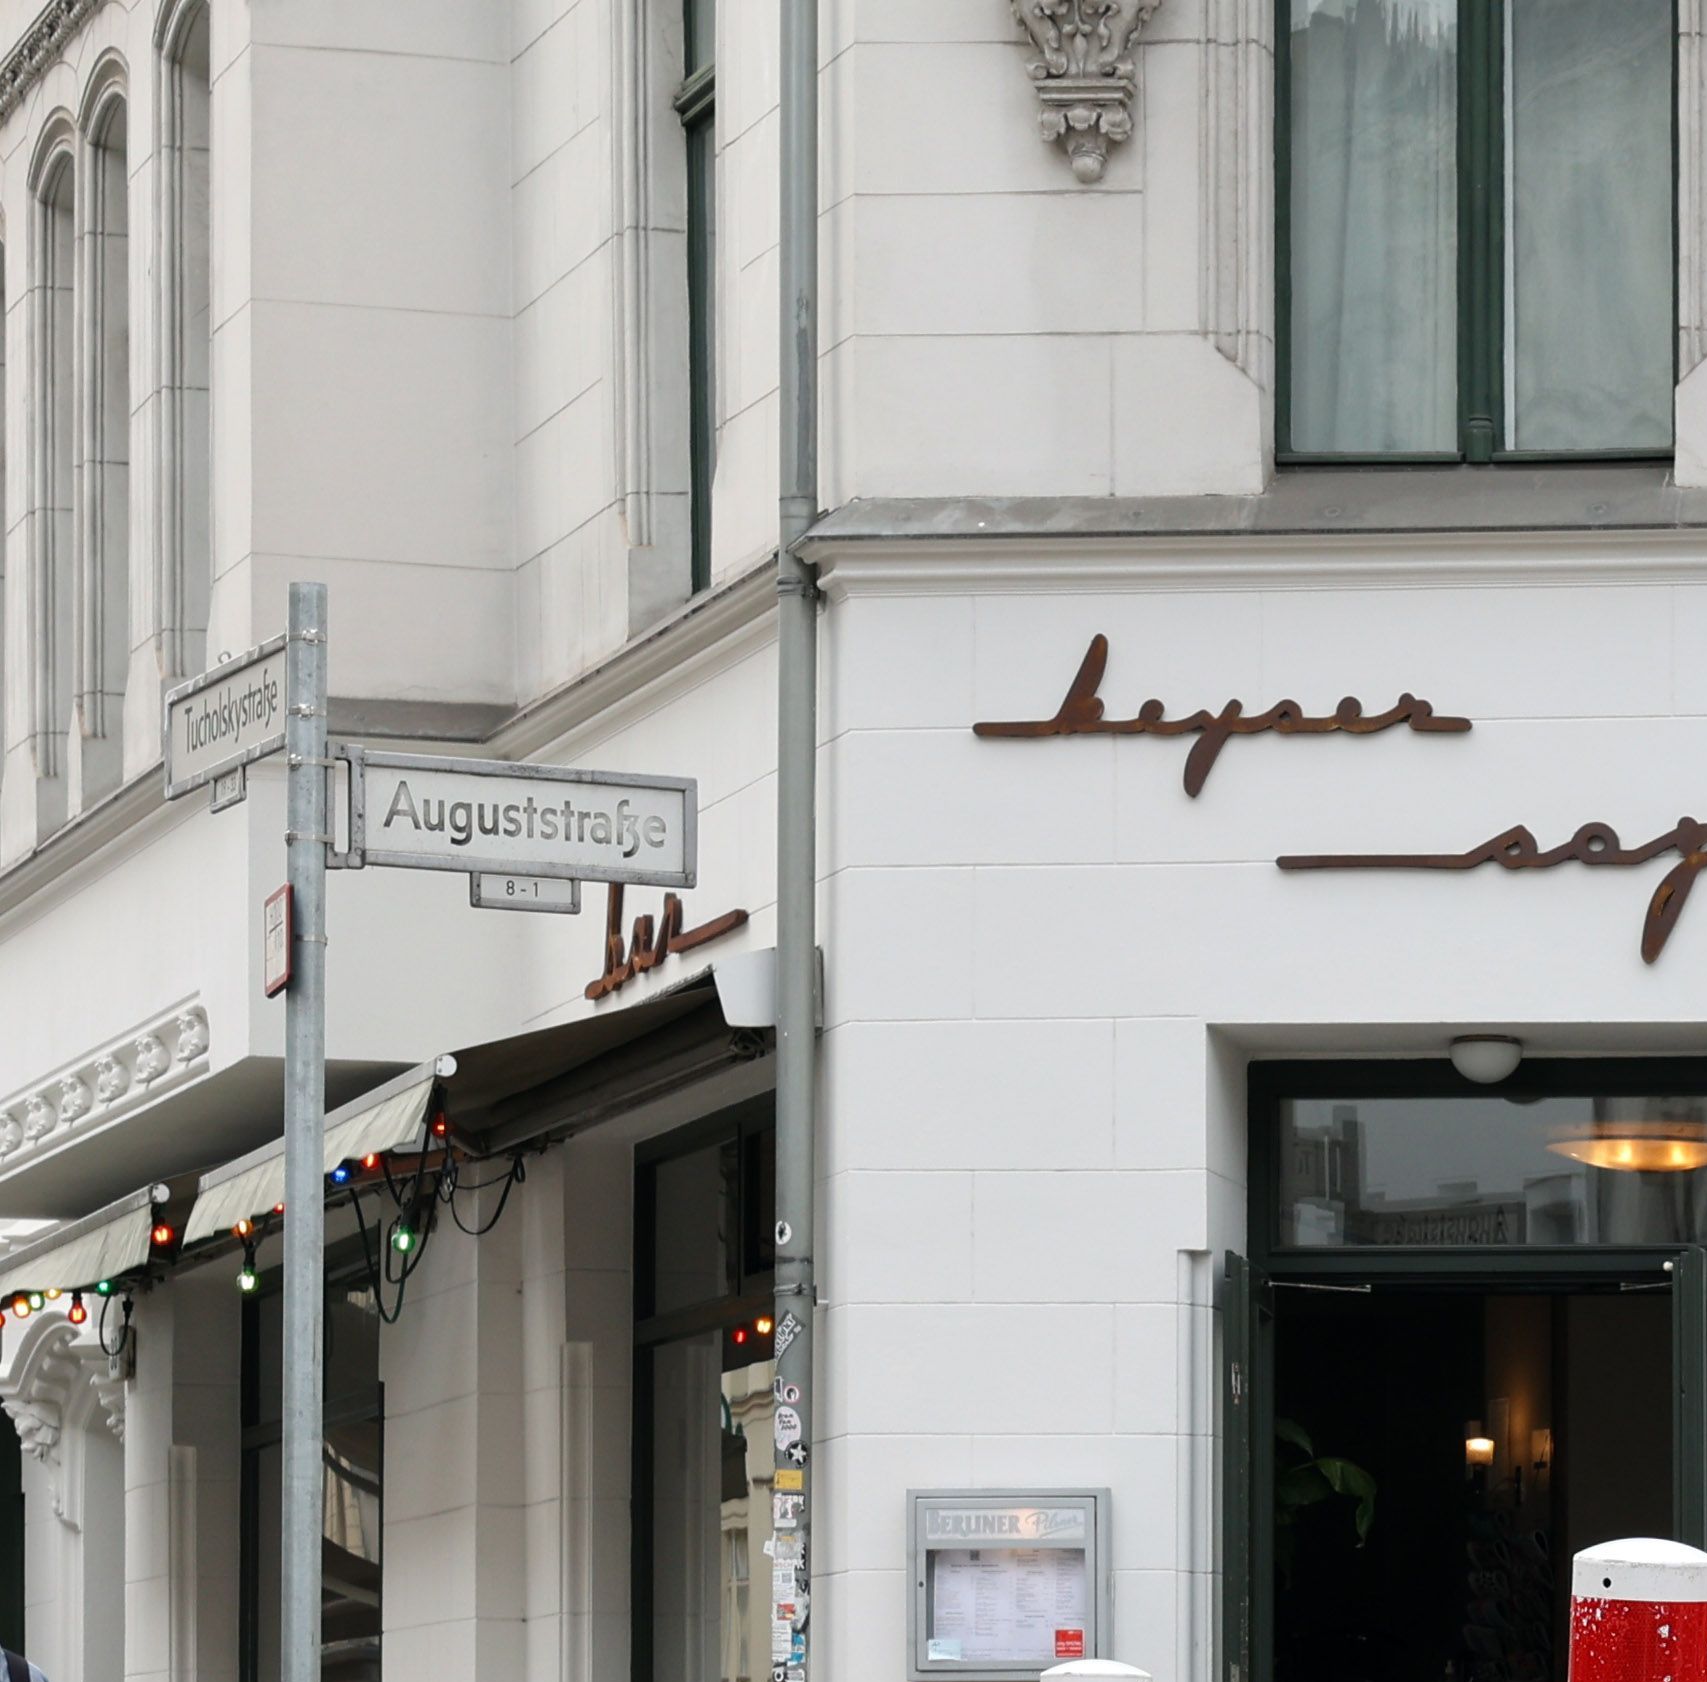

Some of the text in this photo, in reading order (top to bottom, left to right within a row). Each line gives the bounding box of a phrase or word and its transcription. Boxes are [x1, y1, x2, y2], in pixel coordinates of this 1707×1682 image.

[184, 668, 278, 754] Tucholskystraße
[972, 633, 1472, 798] keyser
[383, 780, 667, 859] Auguststraße
[506, 880, 515, 897] 8
[927, 1510, 1021, 1537] BERLINER
